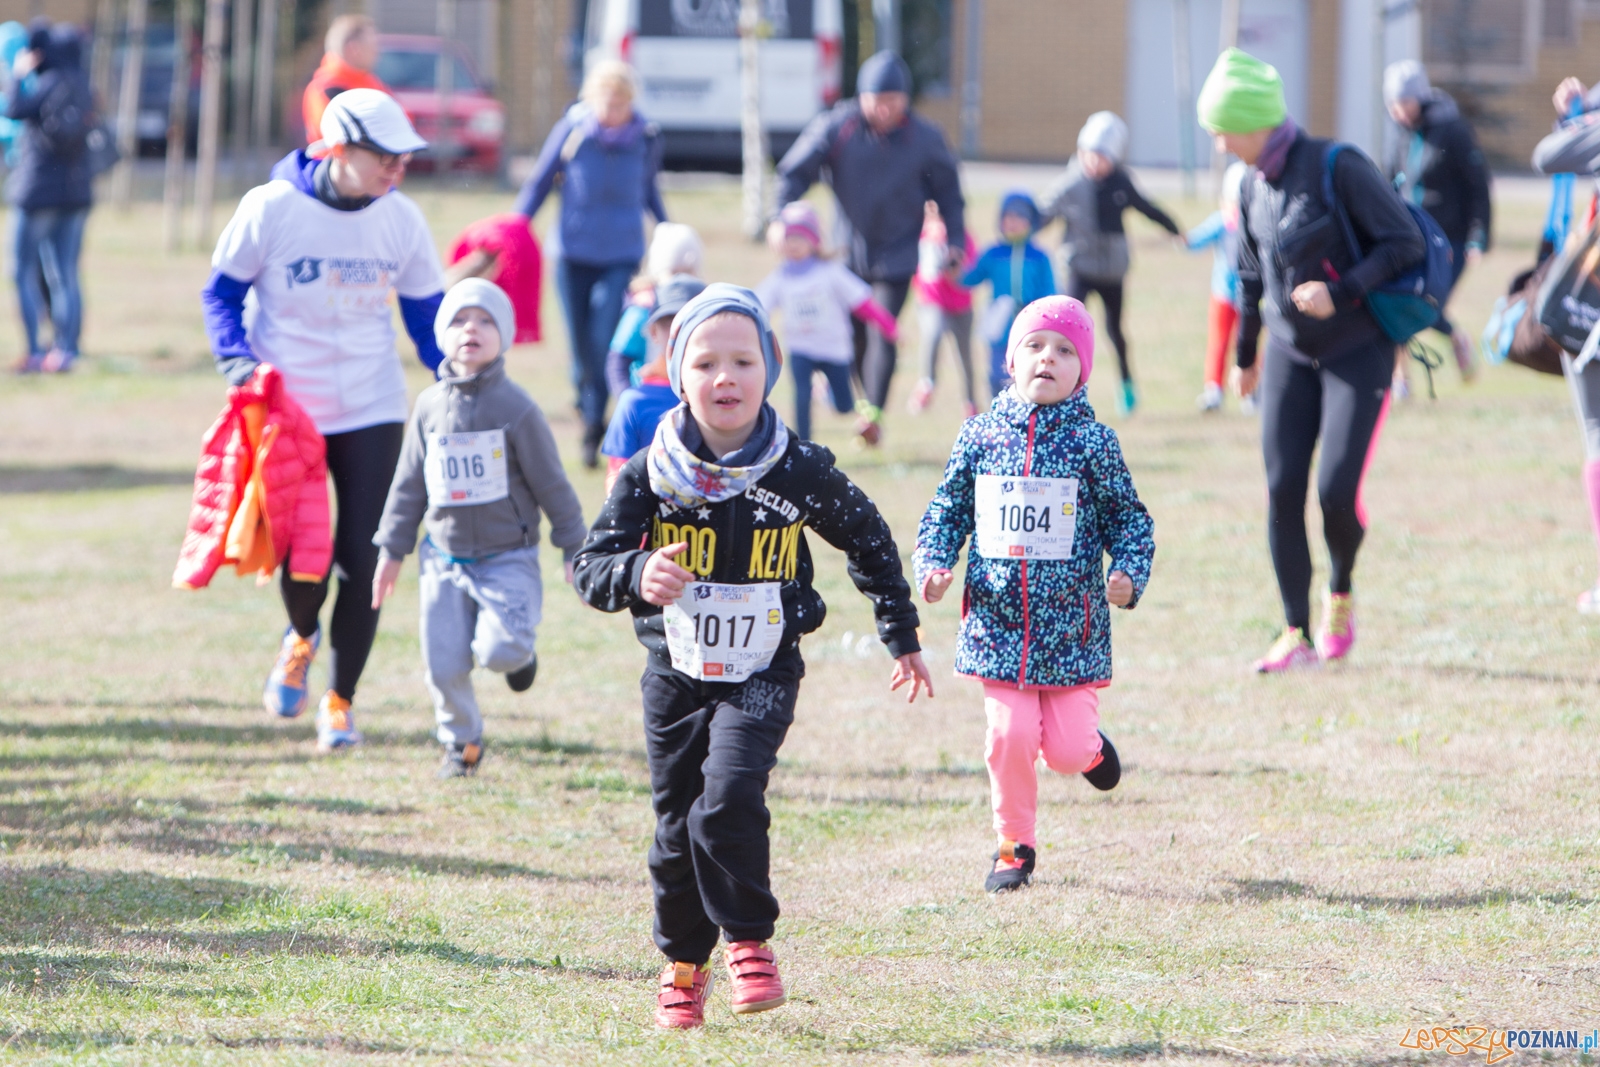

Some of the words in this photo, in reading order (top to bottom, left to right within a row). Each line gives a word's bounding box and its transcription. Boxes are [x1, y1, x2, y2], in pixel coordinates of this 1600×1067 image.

[439, 453, 485, 480] 1016
[999, 504, 1051, 533] 1064
[693, 612, 756, 648] 1017
[741, 687, 774, 711] 1964
